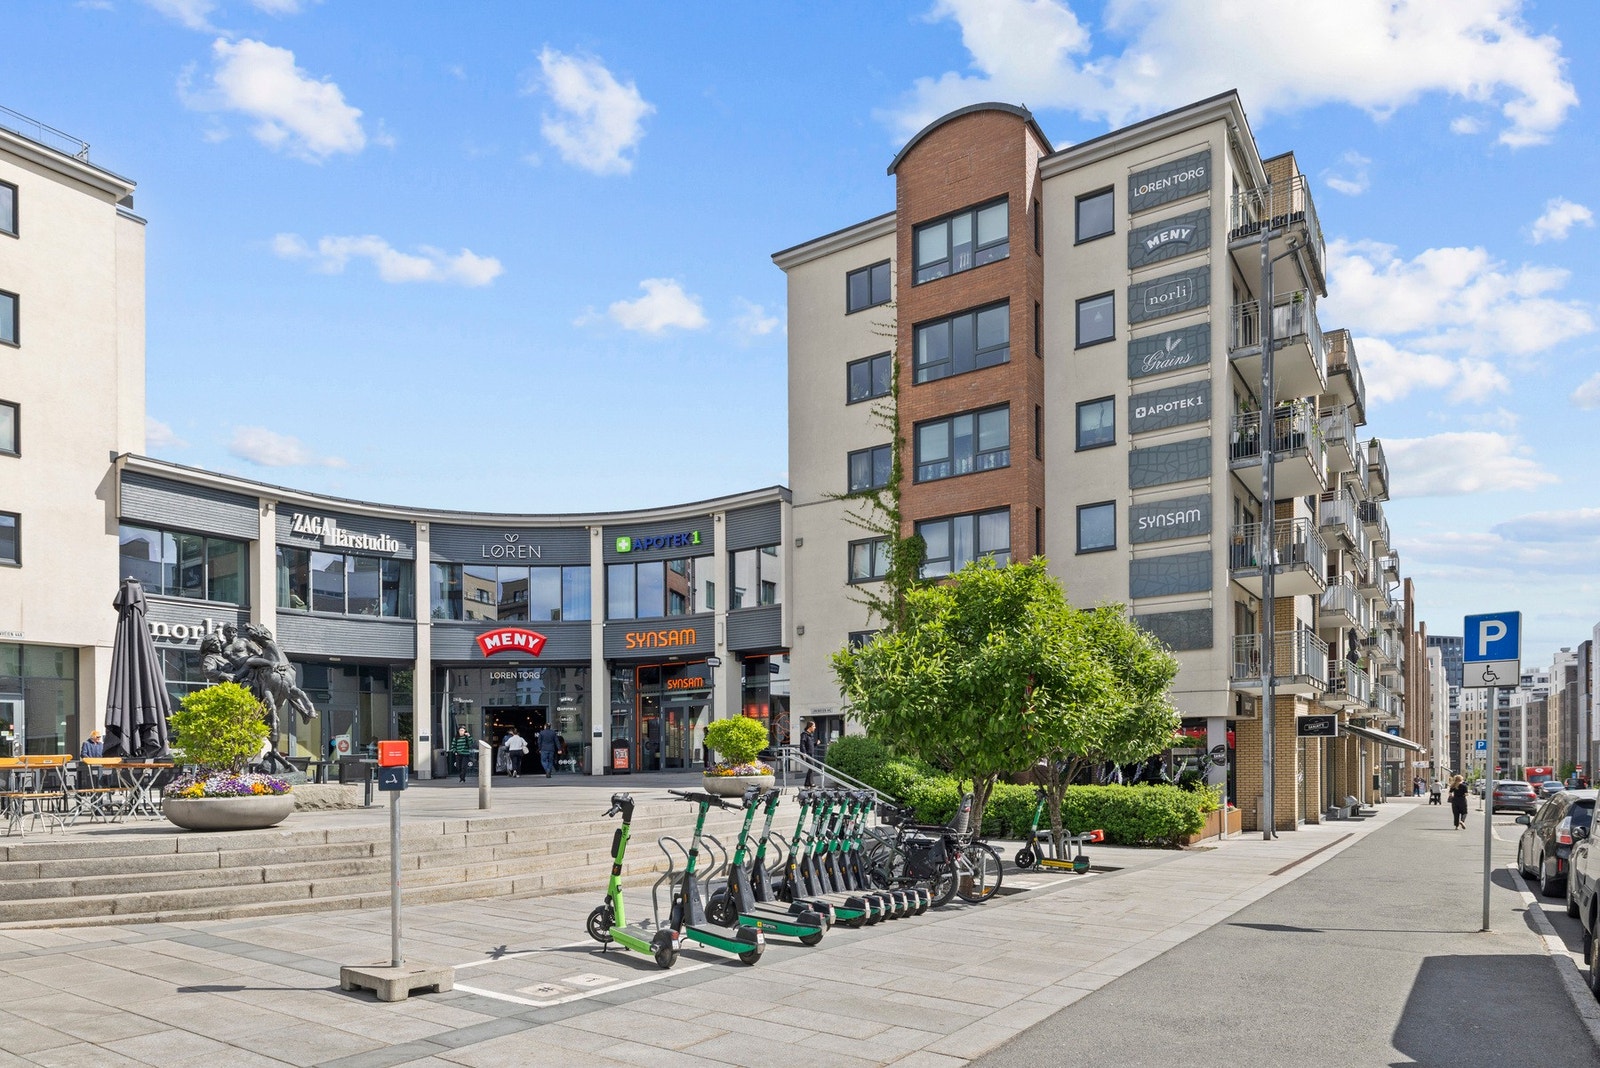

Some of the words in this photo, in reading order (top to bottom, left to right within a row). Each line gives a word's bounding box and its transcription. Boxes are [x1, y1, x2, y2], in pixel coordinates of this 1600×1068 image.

[1173, 167, 1205, 185] TORG
[1147, 229, 1191, 251] MENY
[1150, 285, 1187, 306] norli
[1141, 350, 1194, 373] Grains
[1147, 398, 1195, 417] APOTEK
[1196, 396, 1204, 406] 1
[1138, 509, 1201, 530] SYNSAM
[293, 513, 331, 536] ZAGA
[331, 528, 399, 552] Hårstudio
[633, 534, 690, 551] APOTEK
[692, 530, 702, 545] 1
[482, 545, 541, 558] LØREN
[485, 632, 540, 650] MENY
[625, 628, 697, 649] SYNSAM
[1478, 619, 1508, 656] P
[518, 671, 541, 680] TORG
[667, 677, 704, 690] SYNSAM
[1478, 741, 1484, 749] P
